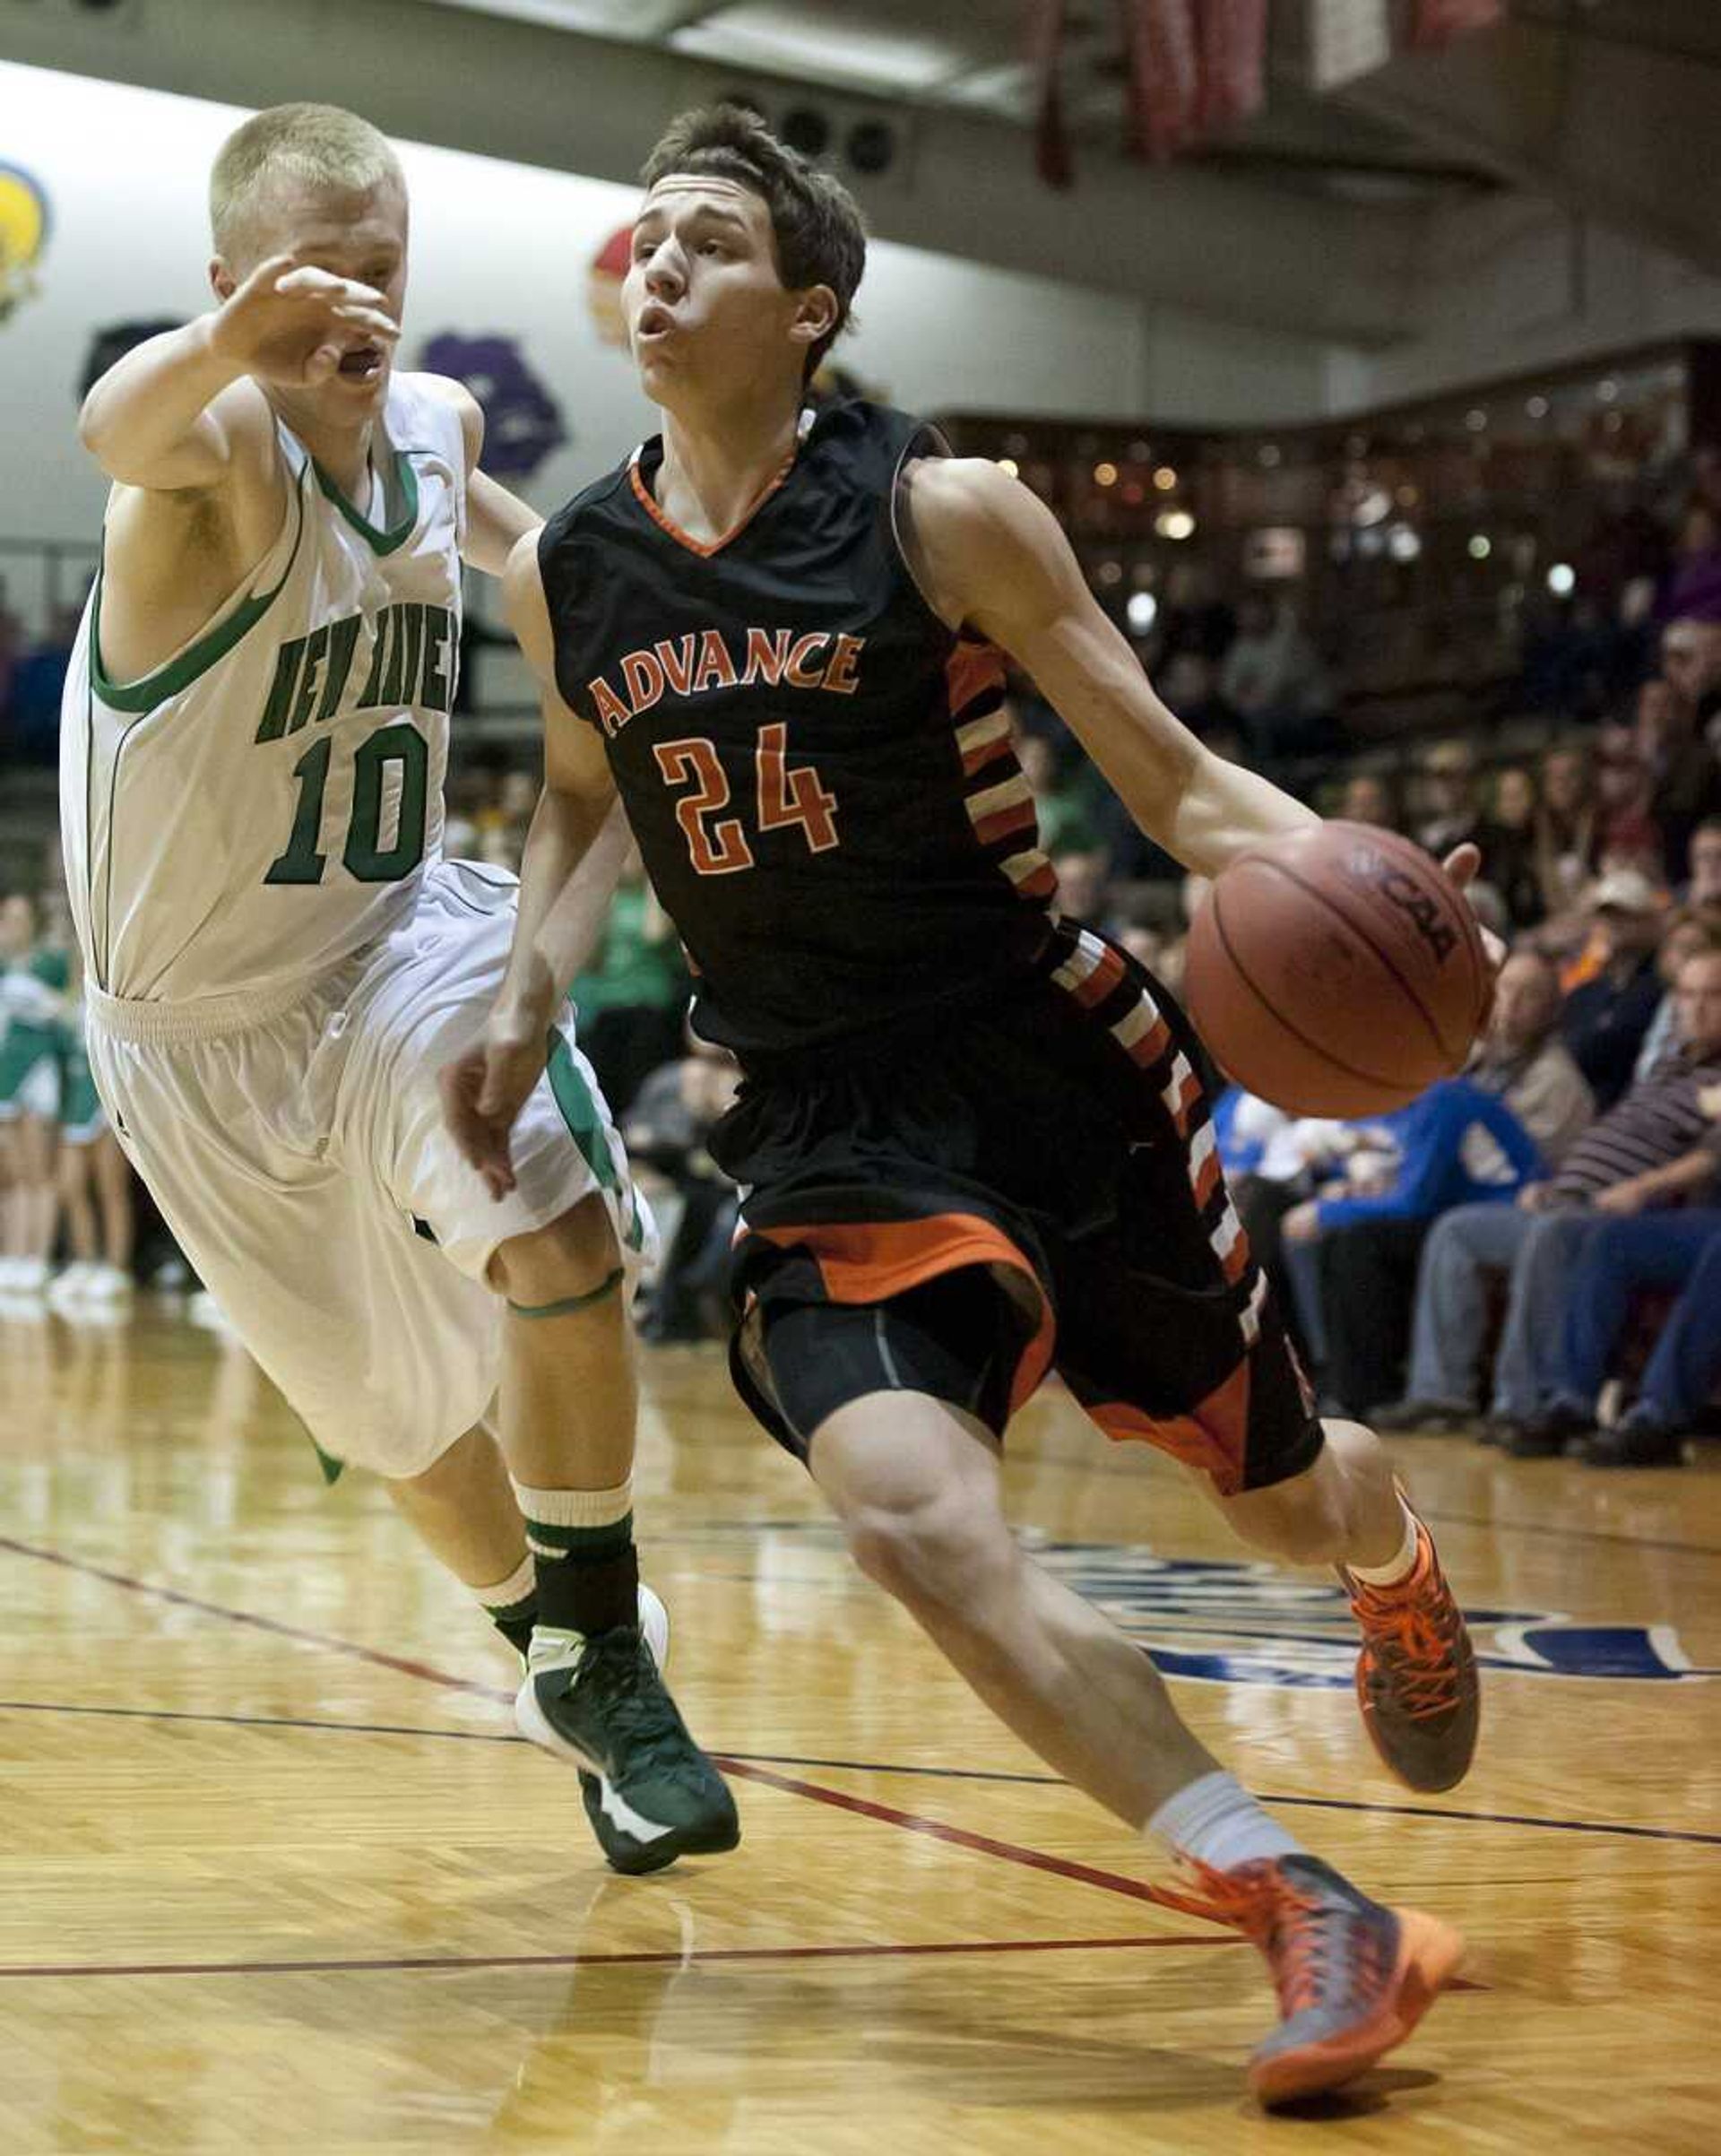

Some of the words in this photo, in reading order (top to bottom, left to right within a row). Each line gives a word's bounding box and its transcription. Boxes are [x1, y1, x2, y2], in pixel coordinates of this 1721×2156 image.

[588, 628, 866, 739] ADVANCE
[263, 723, 428, 884] 10
[653, 722, 839, 875] 24
